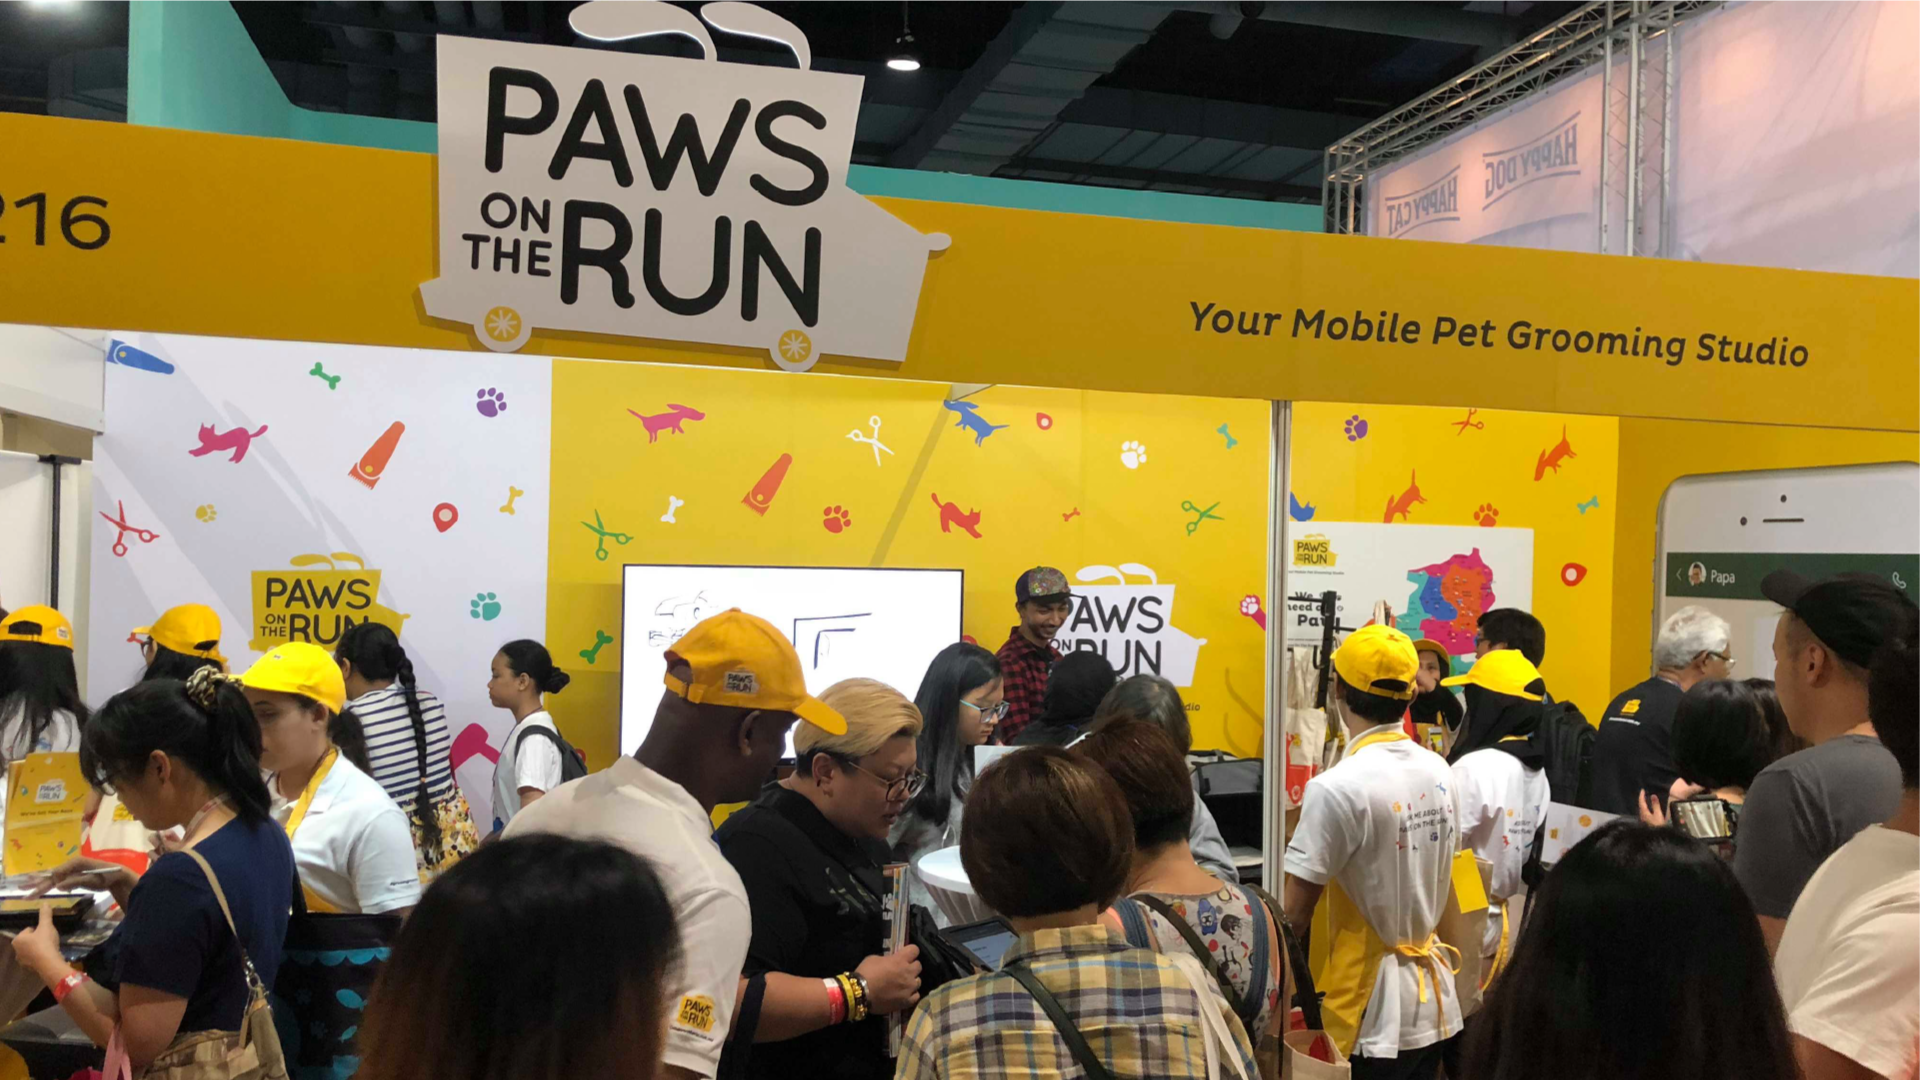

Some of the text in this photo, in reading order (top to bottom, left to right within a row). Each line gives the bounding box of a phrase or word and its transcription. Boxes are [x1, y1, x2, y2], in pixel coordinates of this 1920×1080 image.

[484, 66, 829, 206] PAWS
[0, 192, 111, 250] 16
[480, 192, 551, 234] ON
[462, 199, 822, 328] THE RUN
[1190, 302, 1810, 367] Your Mobile Pet Grooming Studio
[1297, 542, 1328, 553] PAWS
[1303, 553, 1328, 564] RUN
[1710, 569, 1736, 587] Papa
[265, 578, 371, 609] PAWS
[265, 613, 286, 625] ON
[1068, 596, 1164, 634] AWS
[260, 626, 287, 637] THE
[684, 998, 712, 1017] PAWS
[687, 1012, 709, 1028] RUN
